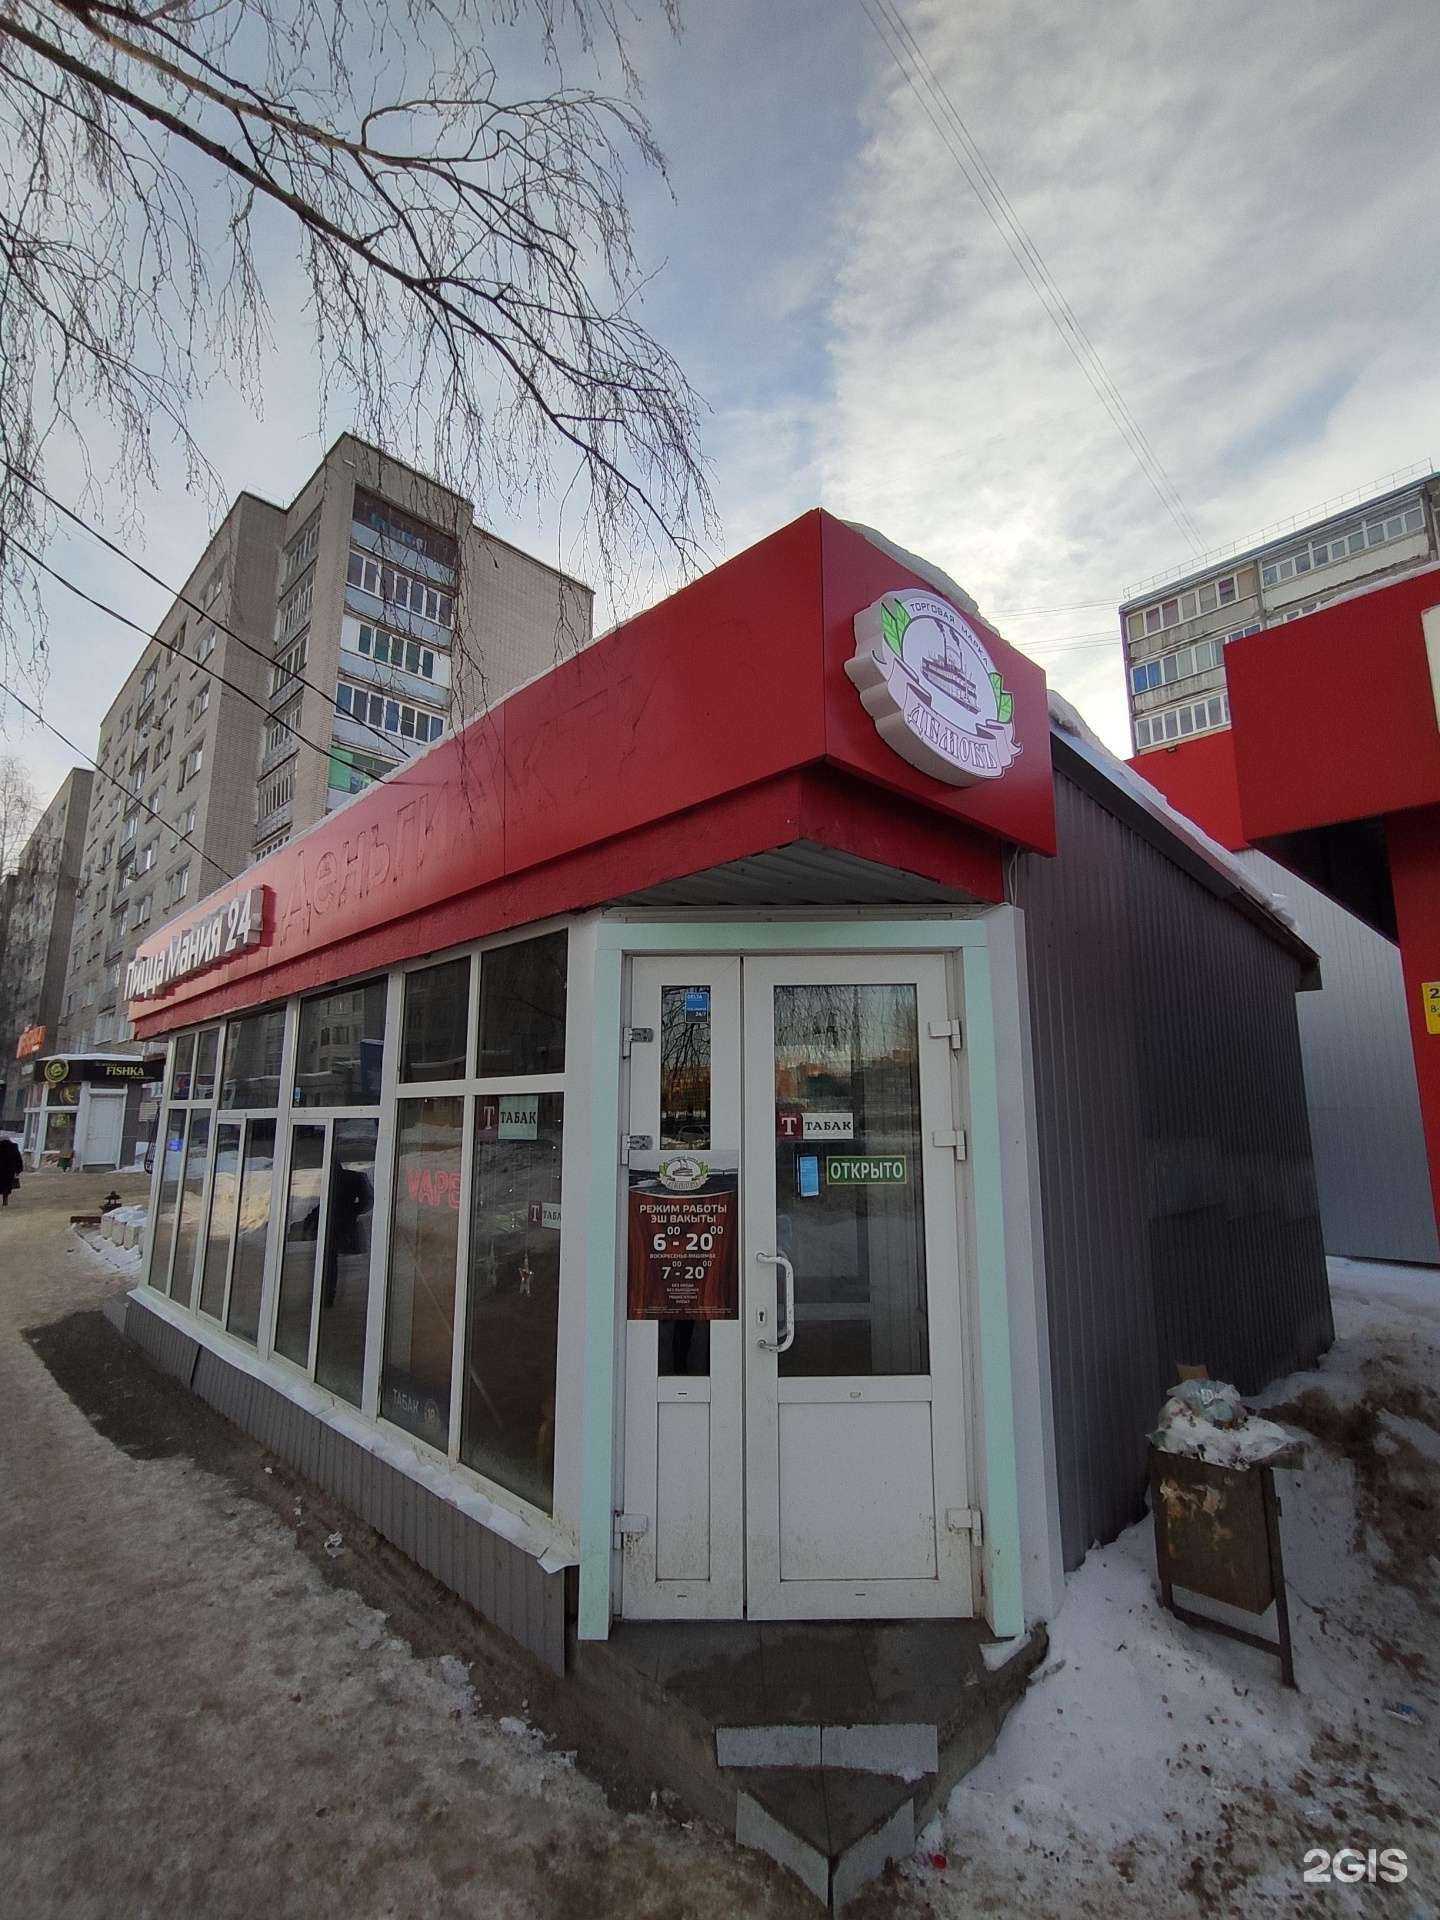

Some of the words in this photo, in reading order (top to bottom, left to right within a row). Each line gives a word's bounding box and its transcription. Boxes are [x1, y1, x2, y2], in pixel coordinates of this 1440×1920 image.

[225, 889, 251, 953] 24
[106, 1066, 144, 1076] FISHKA
[500, 1111, 536, 1125] ТАБАК
[805, 1121, 852, 1131] ТАБАК
[830, 1162, 903, 1179] ОТКРЫТО
[406, 1168, 462, 1209] VAPE
[640, 1204, 680, 1213] РЕЖИМ
[683, 1204, 727, 1213] РАБОТЫ
[650, 1215, 667, 1223] ЭШ
[670, 1215, 717, 1223] ВАКЫТЫ
